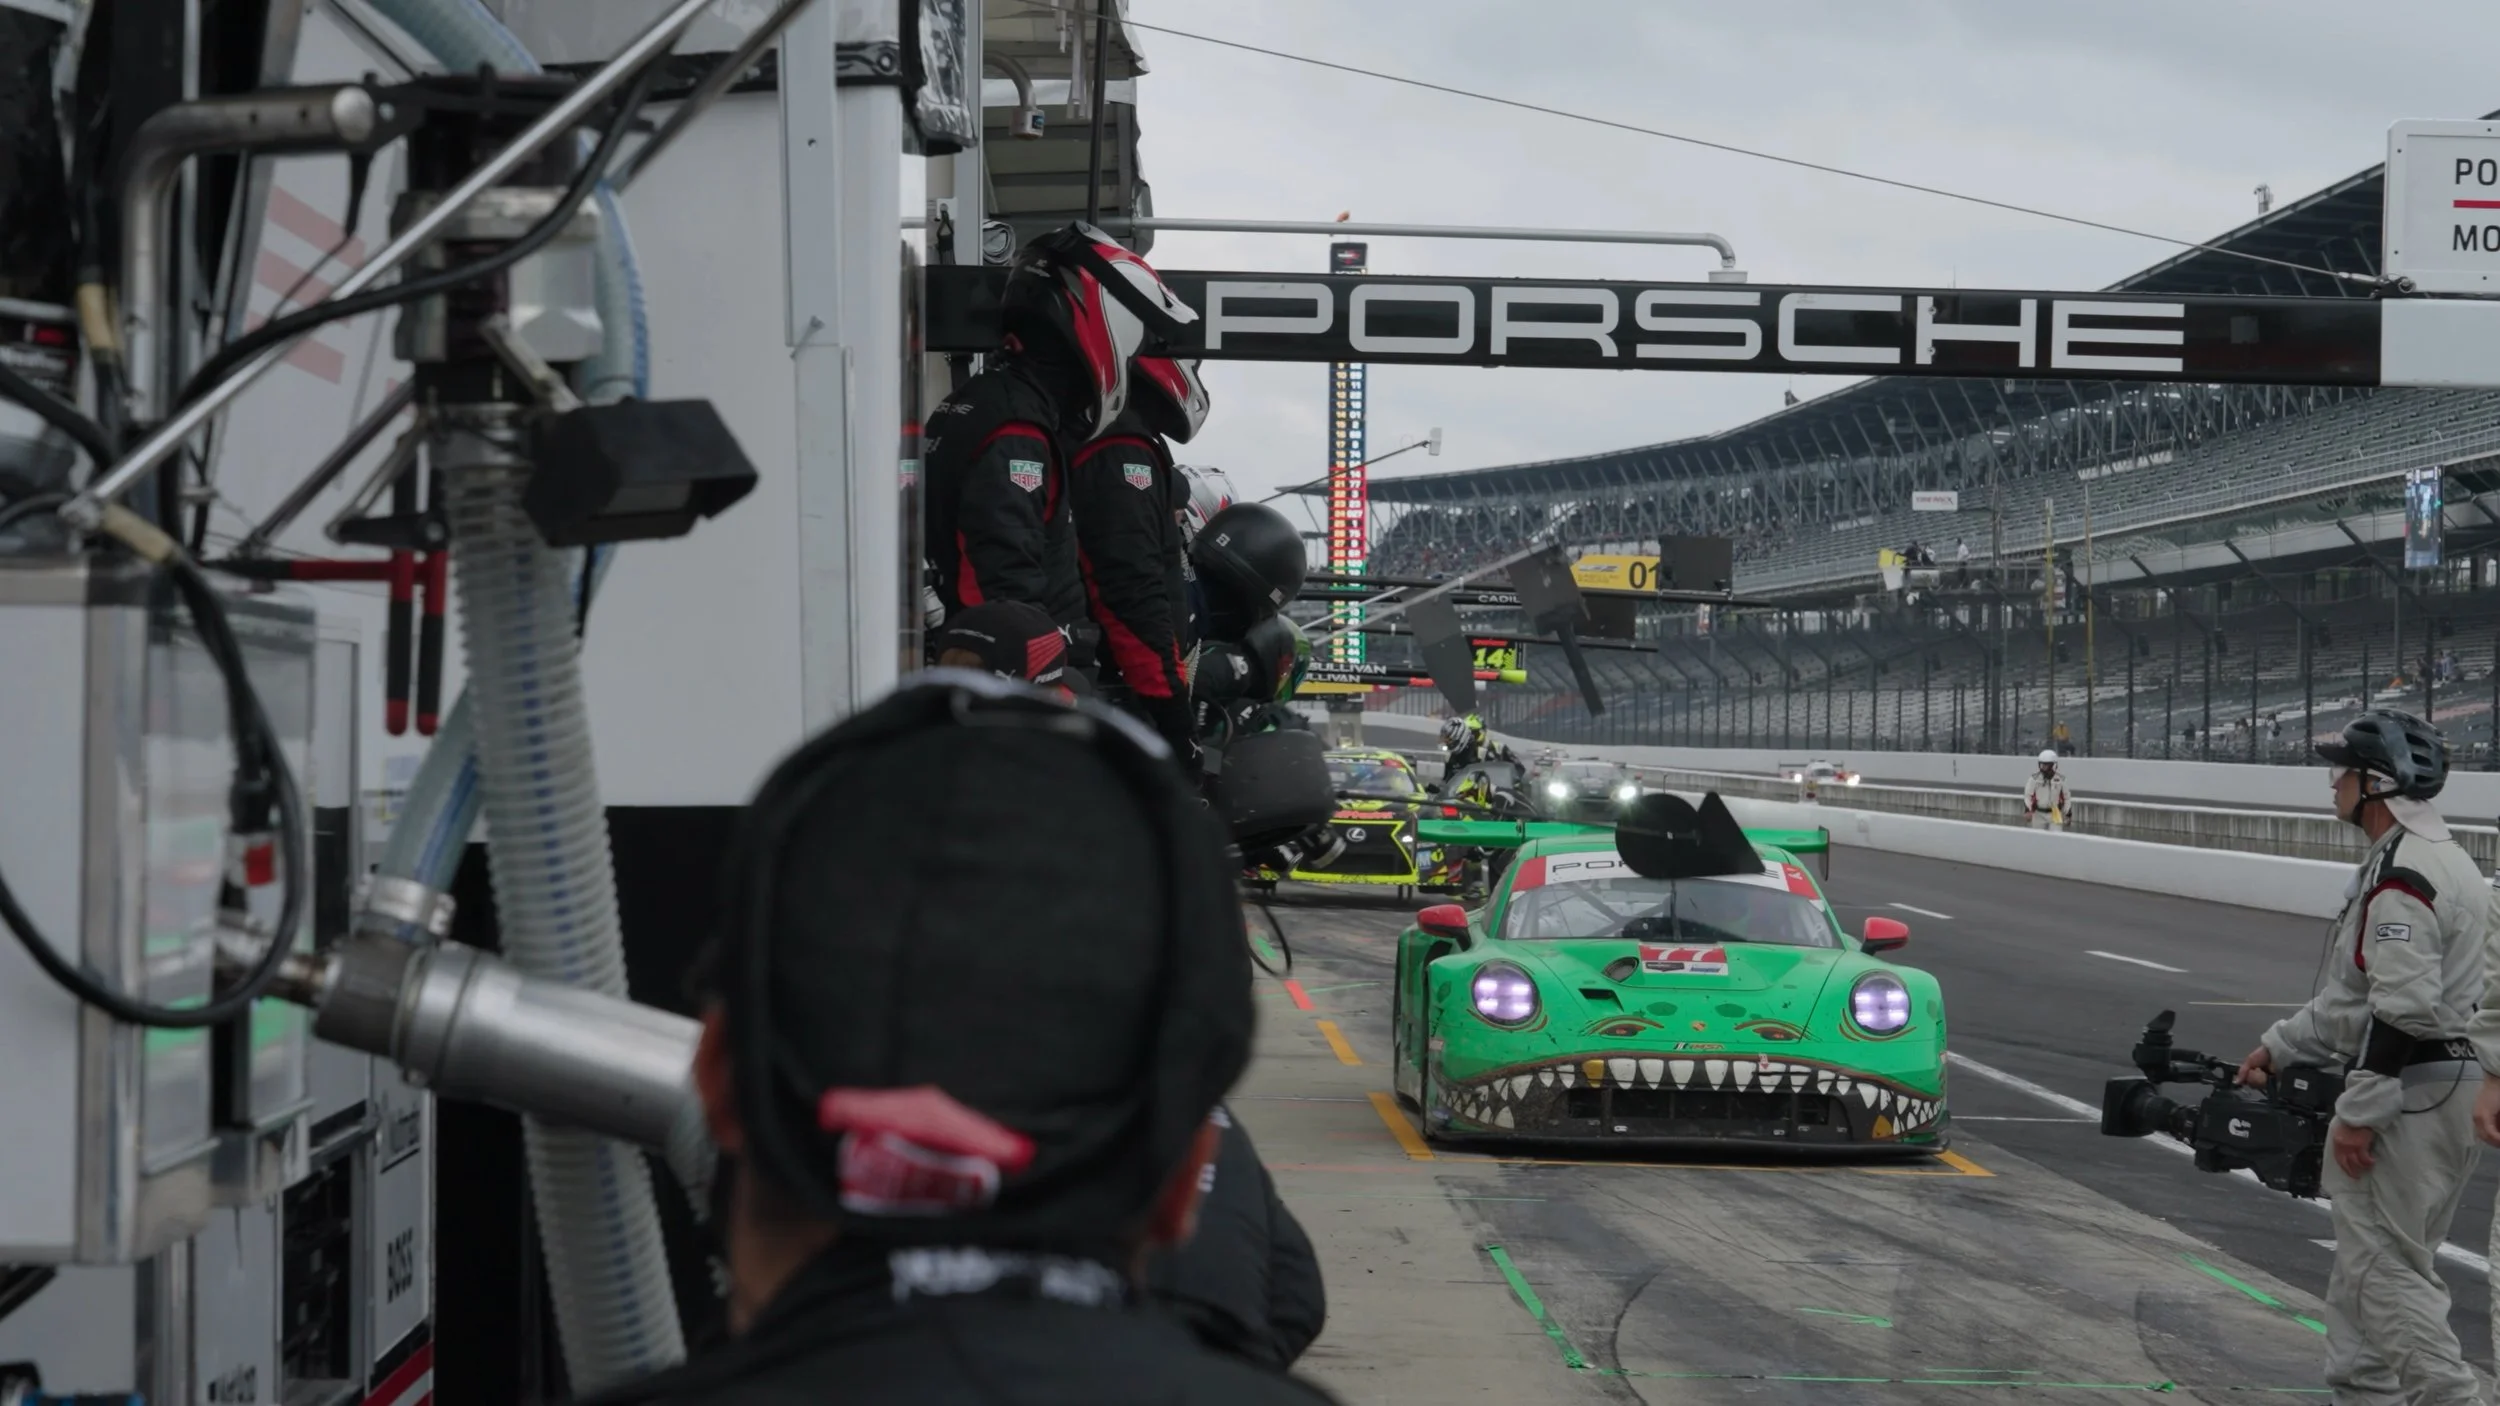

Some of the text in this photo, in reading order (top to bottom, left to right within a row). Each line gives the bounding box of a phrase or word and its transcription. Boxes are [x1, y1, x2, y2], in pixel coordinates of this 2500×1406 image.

[1205, 280, 2184, 372] PORSCHE
[1012, 462, 1042, 474] TAG
[1126, 465, 1150, 475] TAG
[1011, 474, 1042, 489] HEUER
[1126, 475, 1151, 488] HEUER
[1629, 561, 1660, 589] 01
[1473, 647, 1505, 667] 14
[1307, 662, 1387, 674] SULLIVAN
[1648, 947, 1717, 961] 77
[387, 1227, 414, 1304] BOSS
